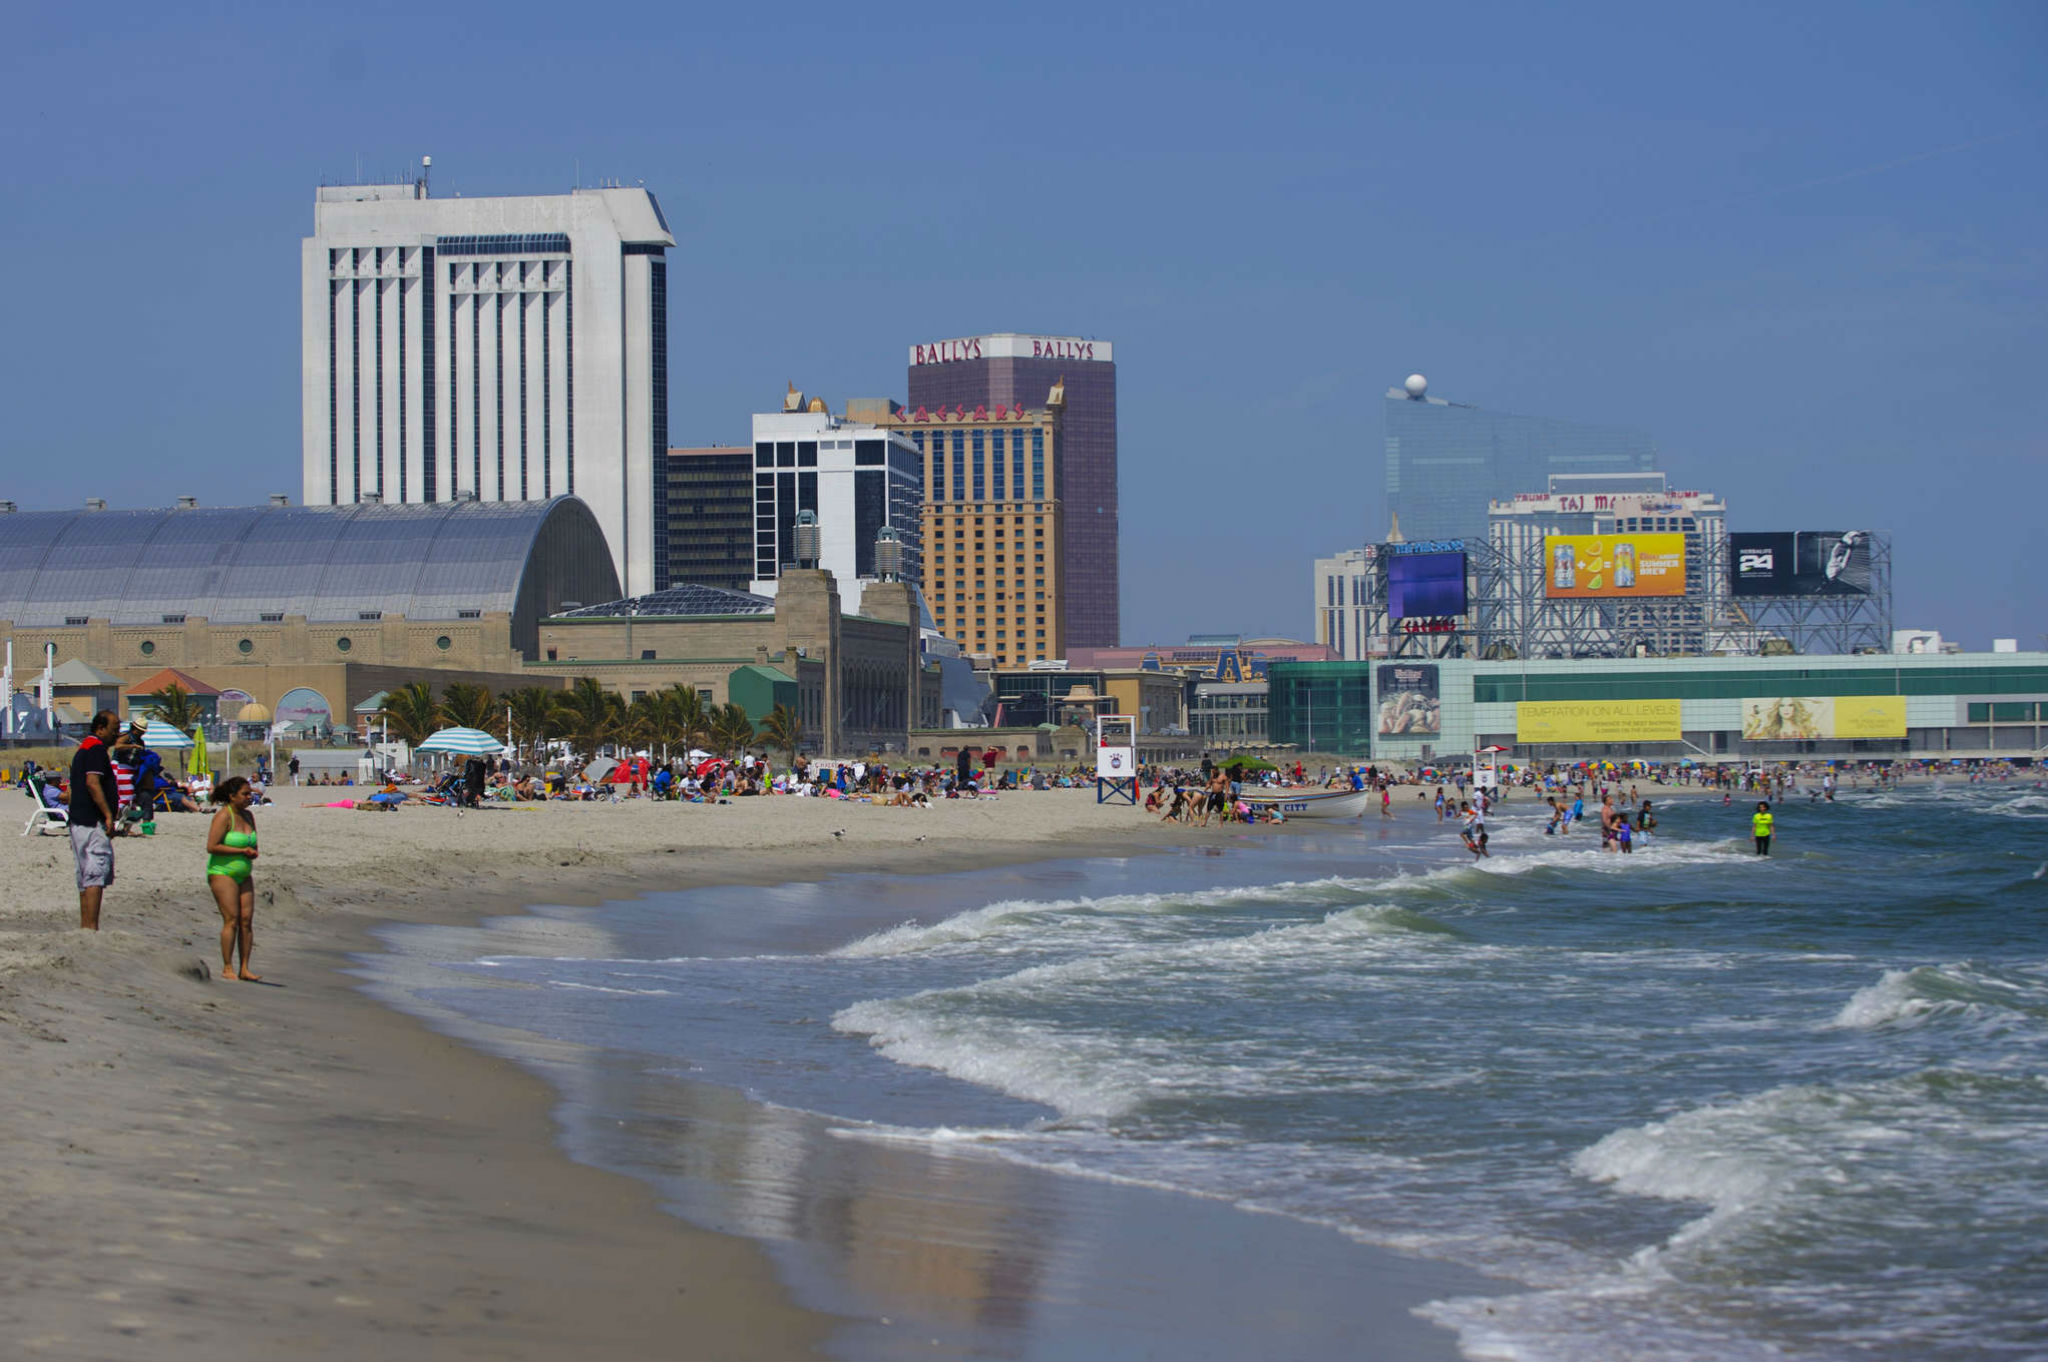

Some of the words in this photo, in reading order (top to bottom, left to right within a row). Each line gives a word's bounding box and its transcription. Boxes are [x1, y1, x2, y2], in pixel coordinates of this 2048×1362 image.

[916, 338, 981, 365] BALLYS
[1033, 340, 1094, 359] BALLYS
[896, 403, 1024, 422] CAESARS
[1515, 494, 1549, 502] TRUMP
[1560, 495, 1583, 511] TAJ
[1640, 560, 1679, 568] SUMMER
[1740, 554, 1773, 572] 24
[1520, 706, 1589, 717] TEMPTATION
[1592, 706, 1610, 717] ON
[1613, 705, 1633, 716] ALL
[1636, 705, 1677, 715] LEVELS
[1284, 803, 1308, 811] CITY
